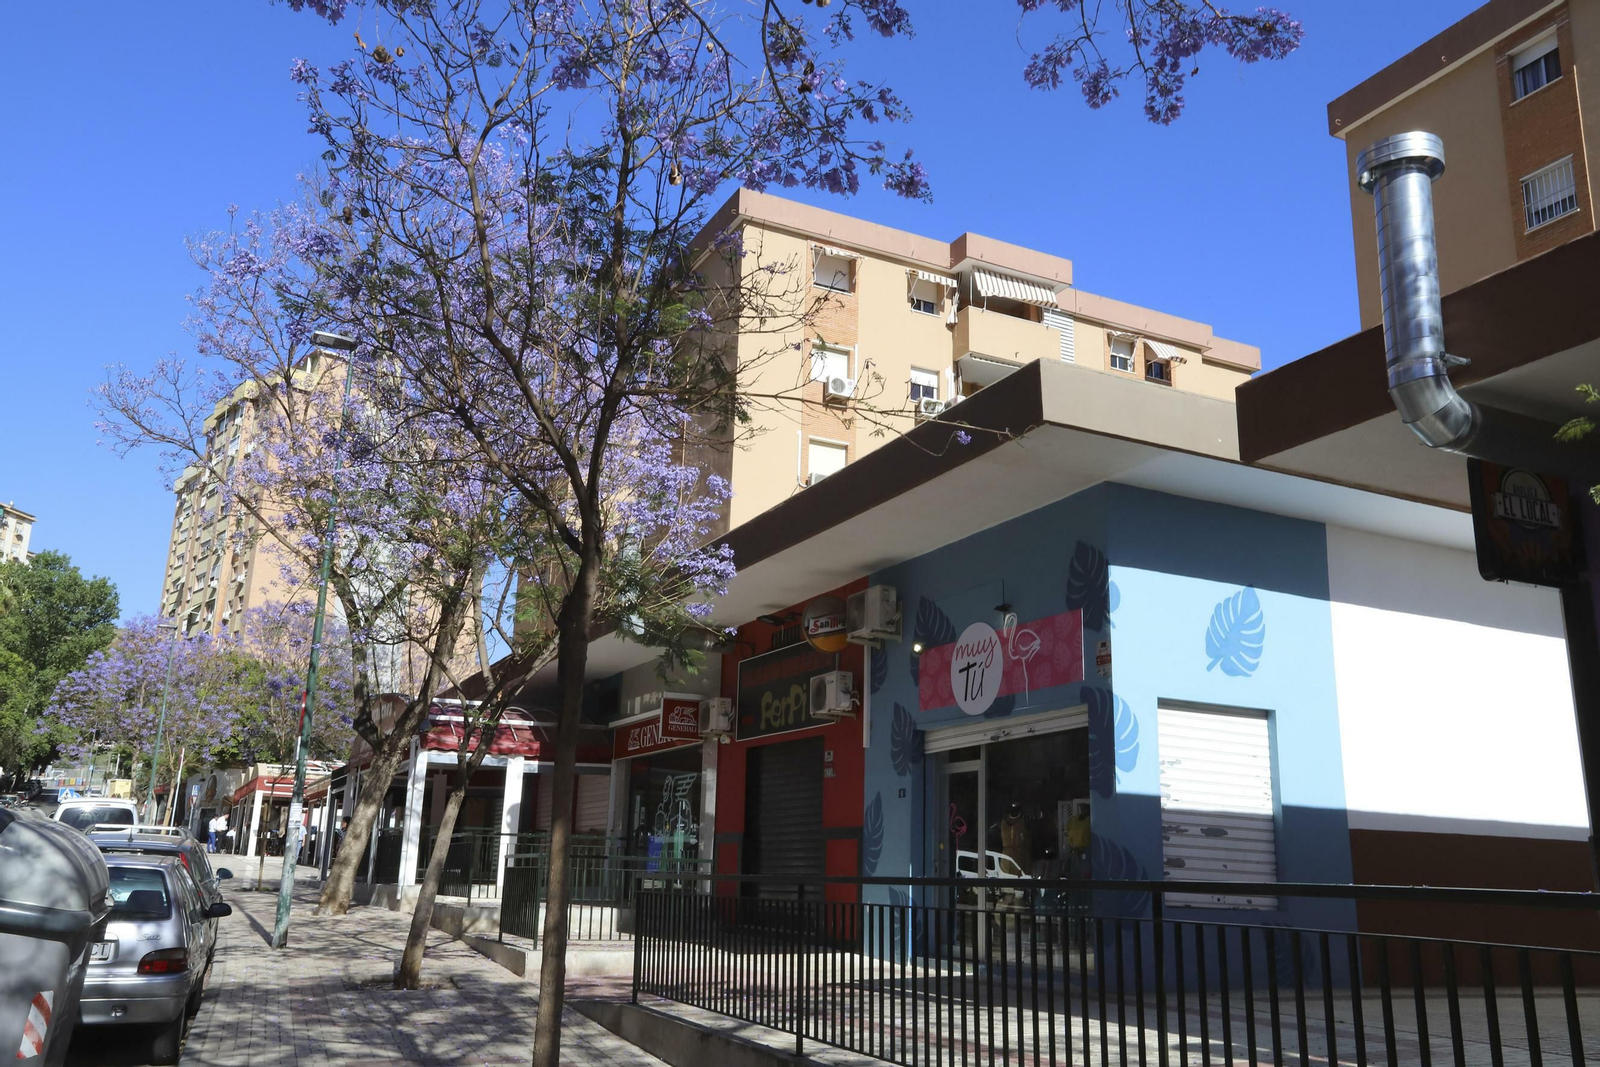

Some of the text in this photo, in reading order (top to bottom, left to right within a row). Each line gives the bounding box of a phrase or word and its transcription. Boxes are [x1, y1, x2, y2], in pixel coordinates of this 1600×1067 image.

[1503, 494, 1553, 524] EL LOCAL
[810, 618, 830, 633] San
[955, 636, 997, 668] muy
[668, 724, 697, 733] GENERALI
